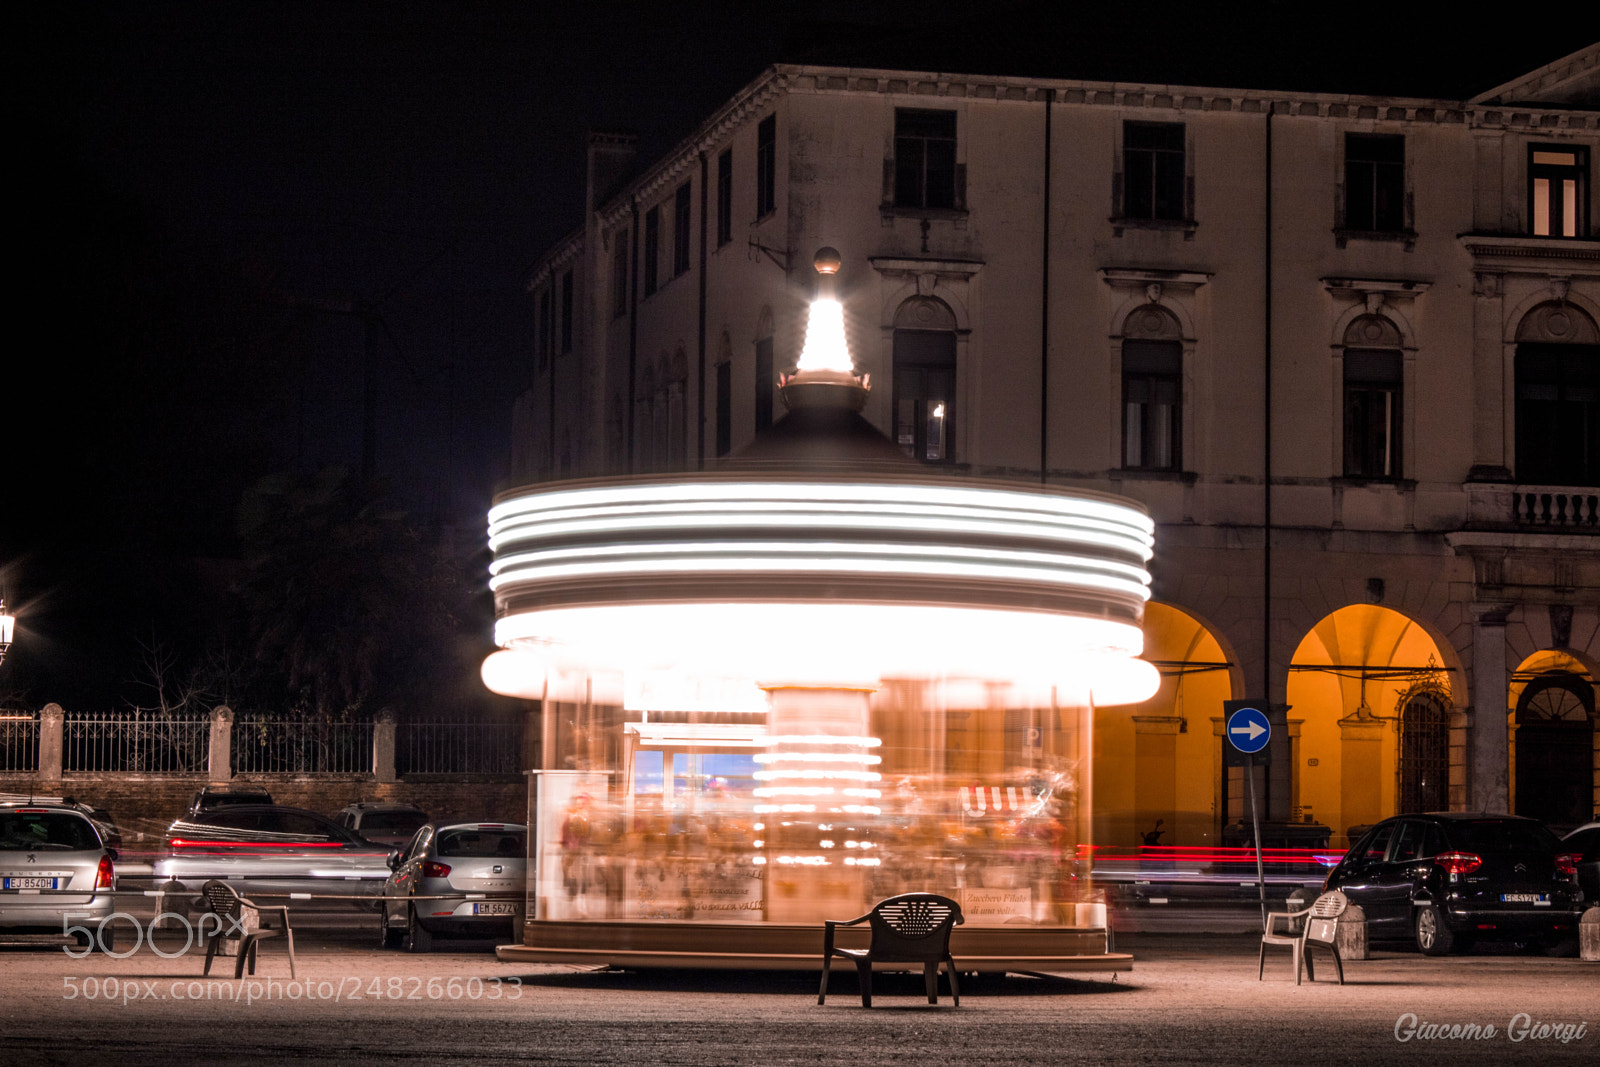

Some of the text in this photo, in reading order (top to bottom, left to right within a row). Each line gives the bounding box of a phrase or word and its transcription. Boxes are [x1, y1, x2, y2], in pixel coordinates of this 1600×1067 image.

[11, 878, 52, 888] EJ 854DH
[479, 904, 490, 913] EM
